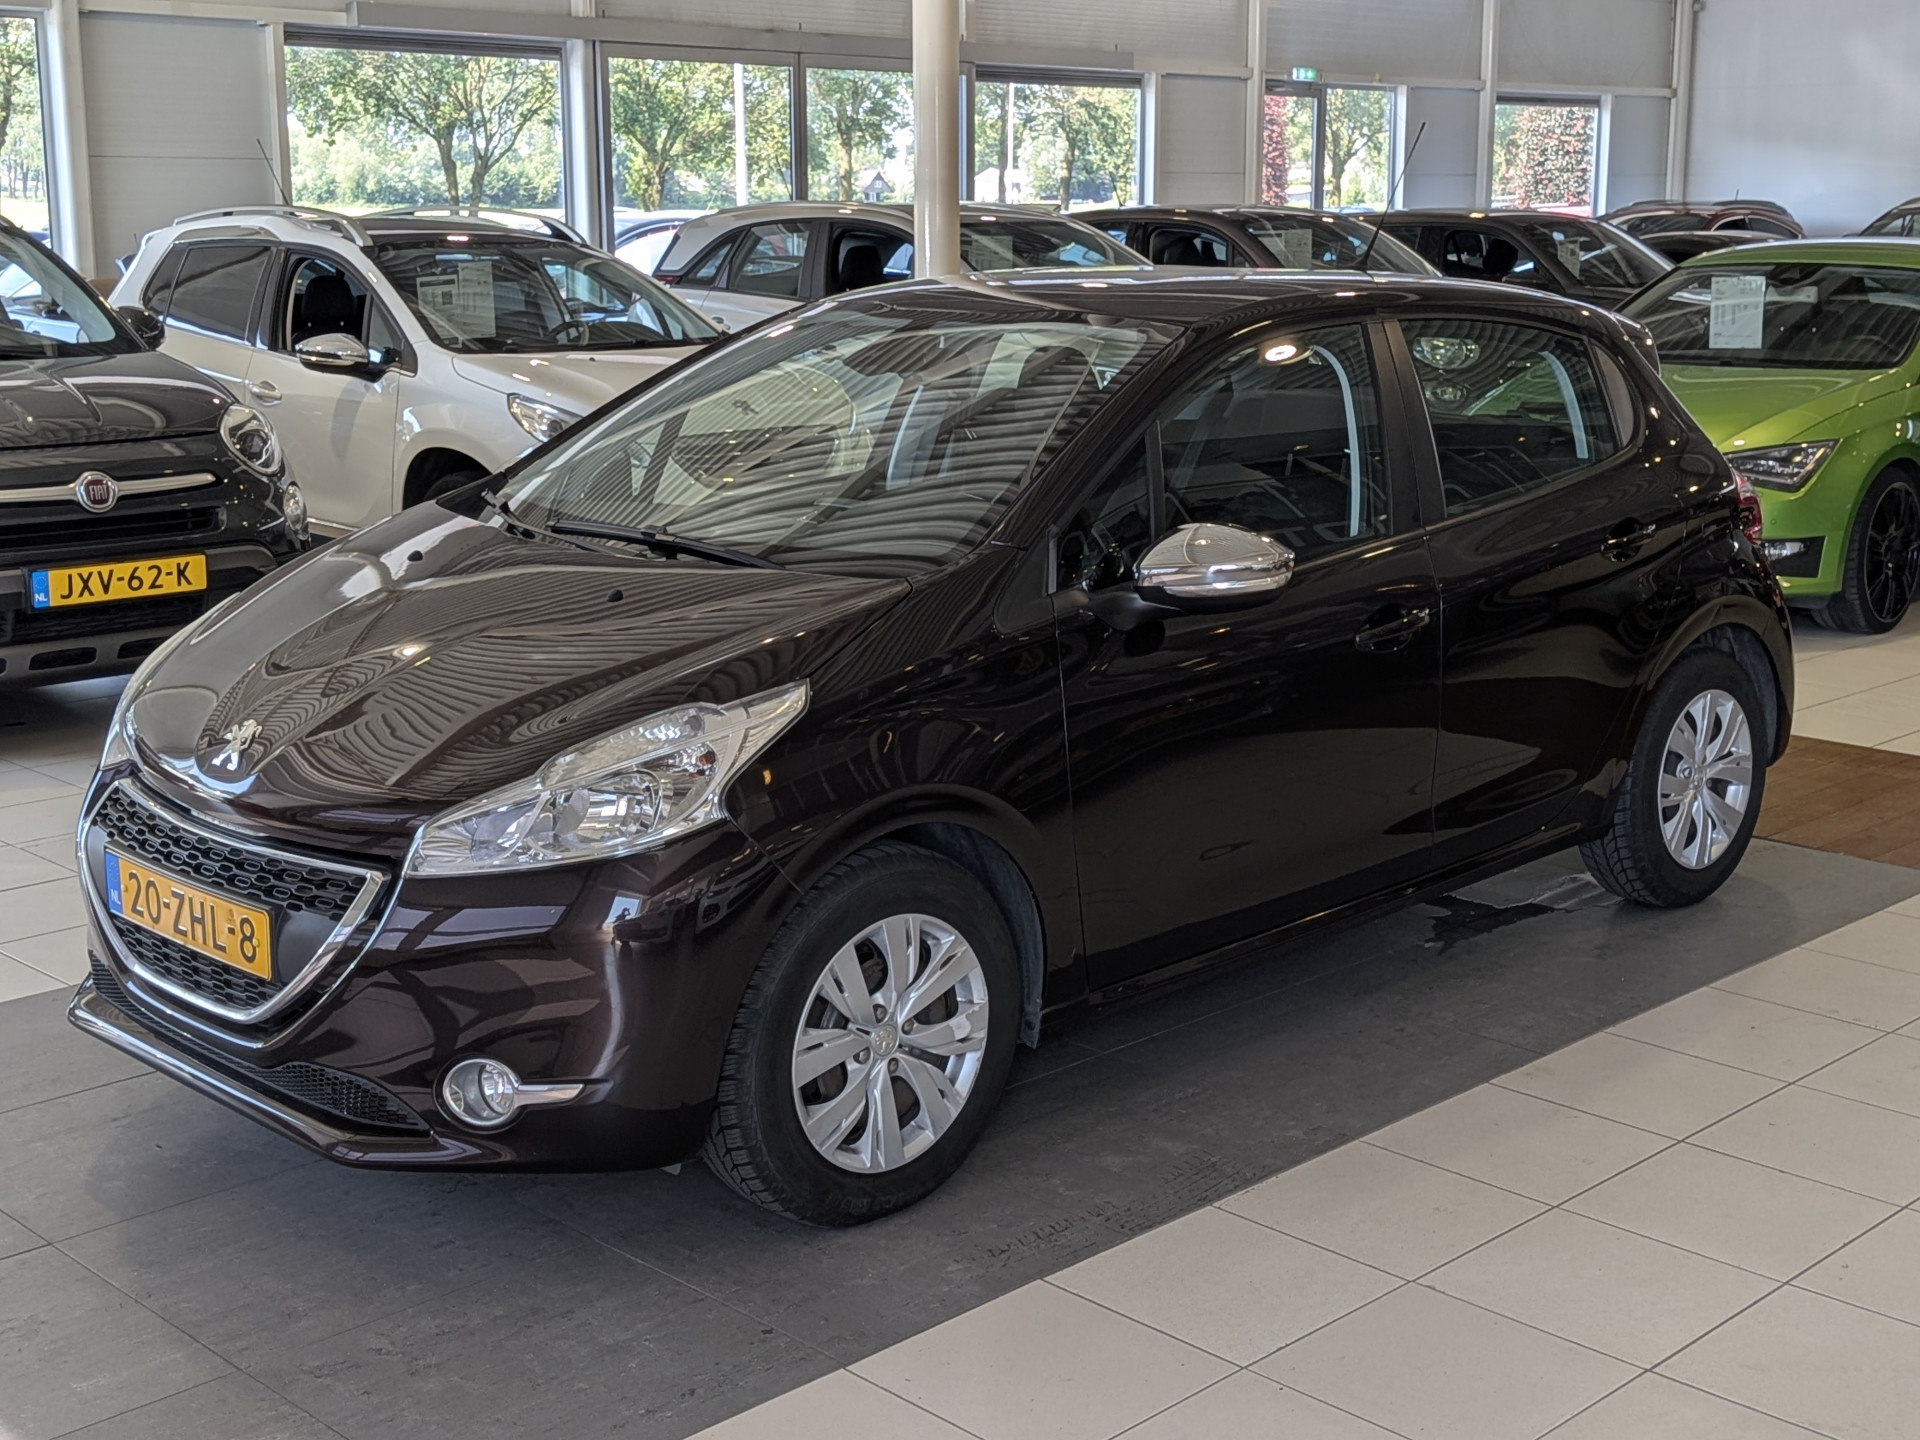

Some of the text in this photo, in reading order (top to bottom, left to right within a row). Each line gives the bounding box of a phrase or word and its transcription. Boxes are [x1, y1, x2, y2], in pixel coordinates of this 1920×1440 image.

[88, 484, 108, 501] FIAT
[34, 561, 193, 603] NL JXV-62-K
[110, 870, 257, 964] NL 20-ZHL-8
